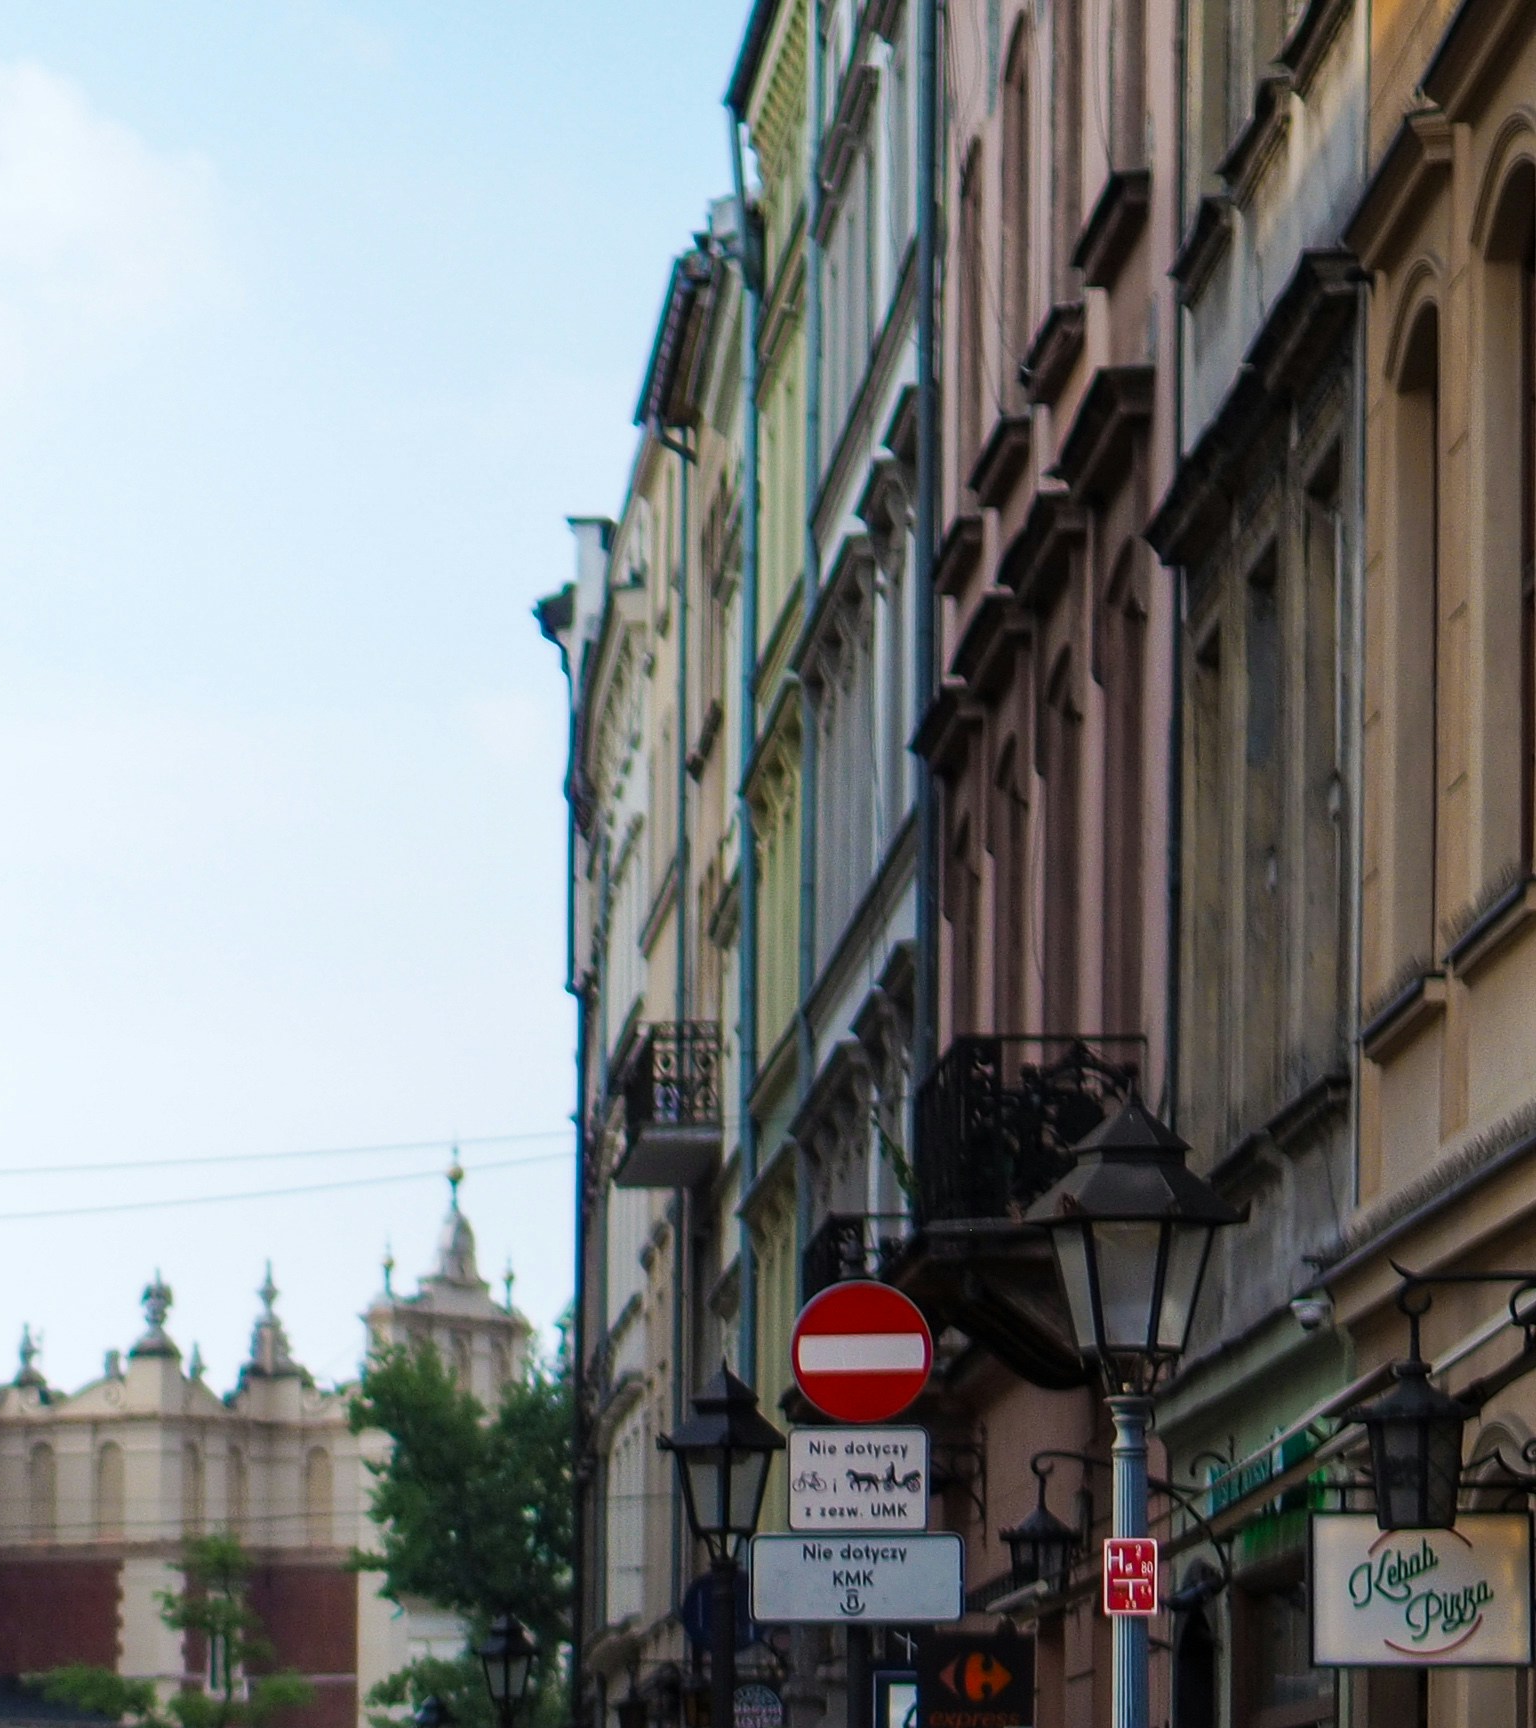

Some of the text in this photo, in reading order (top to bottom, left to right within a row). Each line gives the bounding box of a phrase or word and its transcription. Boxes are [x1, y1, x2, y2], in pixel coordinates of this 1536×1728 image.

[809, 1441, 908, 1460] Nie dotyczy
[805, 1507, 811, 1517] z
[871, 1503, 908, 1518] UMK
[802, 1544, 907, 1564] Nie dotyczy
[832, 1570, 874, 1588] KMK
[1349, 1536, 1439, 1609] Kebab
[1405, 1579, 1494, 1641] Pizza
